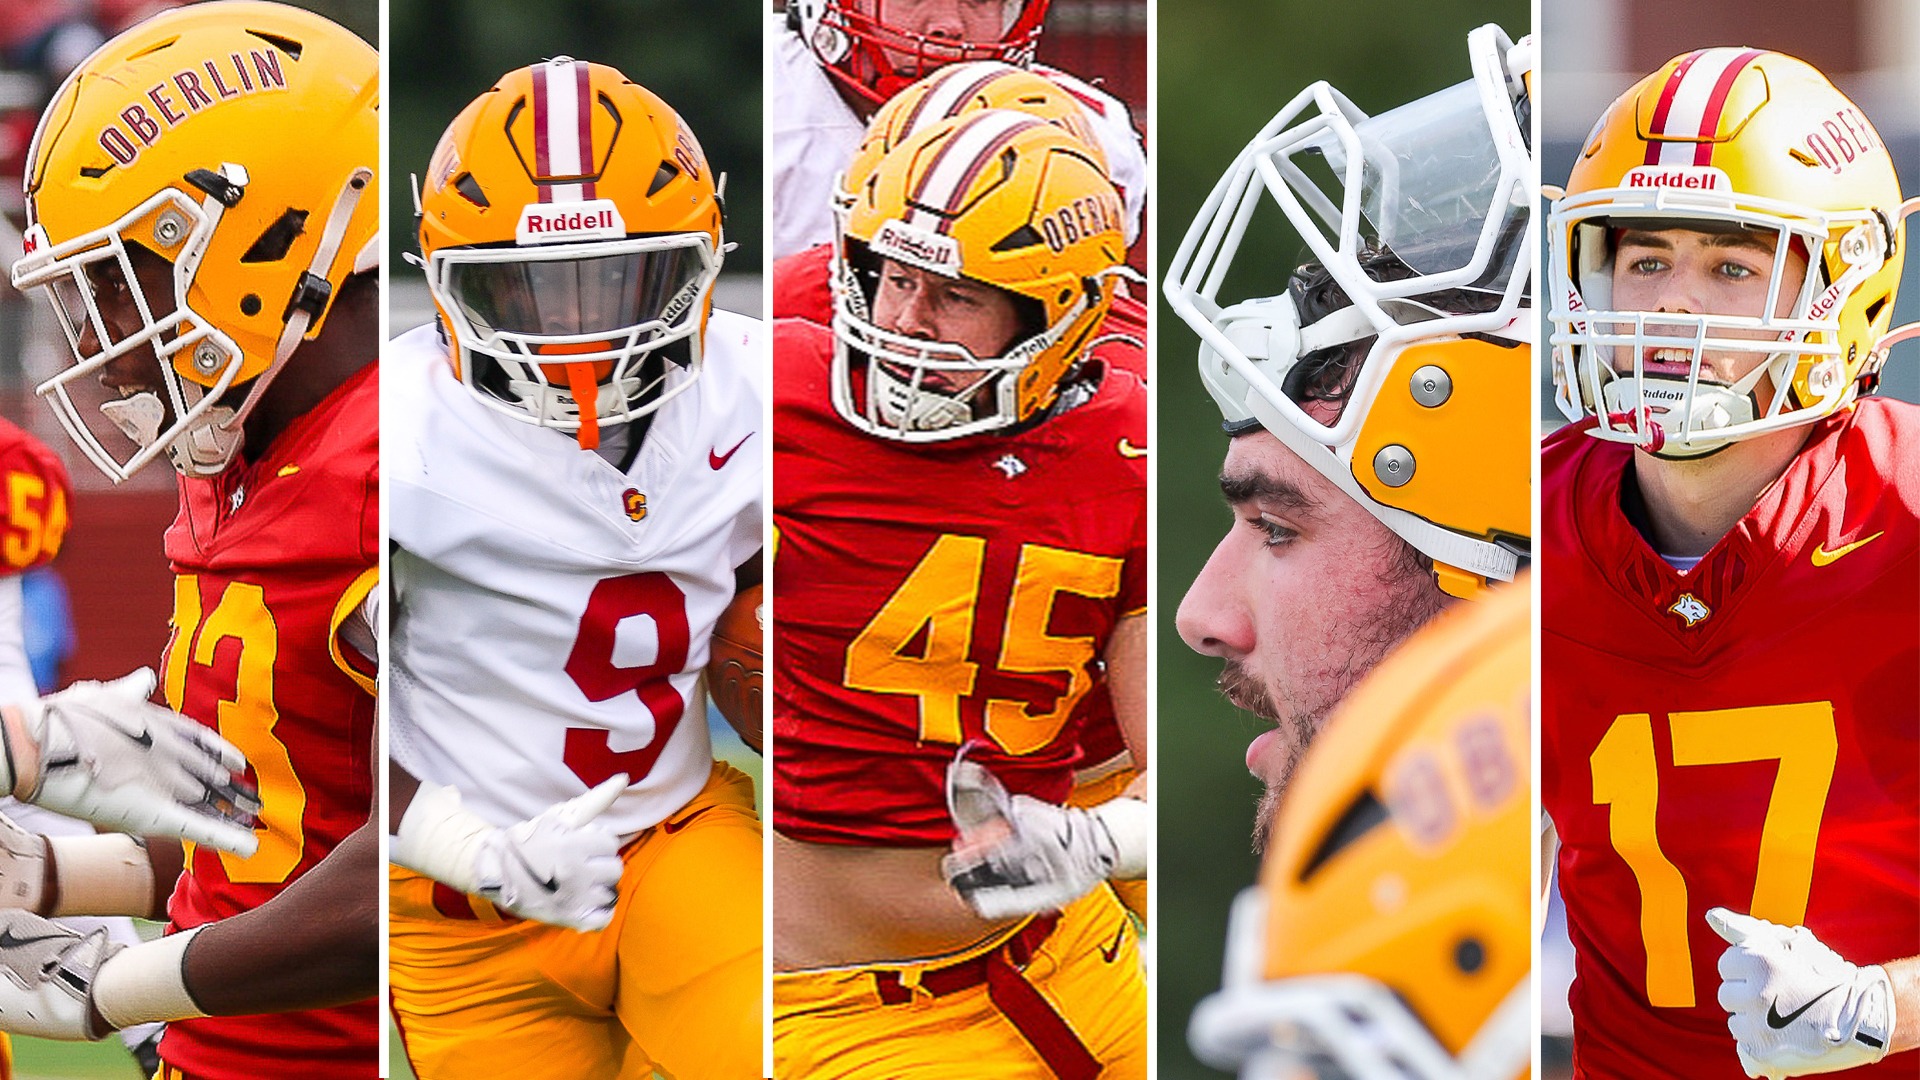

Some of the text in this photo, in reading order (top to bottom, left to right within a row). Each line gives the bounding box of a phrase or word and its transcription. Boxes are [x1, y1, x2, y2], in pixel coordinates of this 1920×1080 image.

[99, 49, 285, 165] OBERLIN
[527, 210, 614, 234] Riddell
[1629, 171, 1717, 191] Riddell
[657, 282, 700, 324] iddell
[563, 571, 691, 789] 9
[844, 533, 1125, 756] 45
[1589, 700, 1839, 1008] 17
